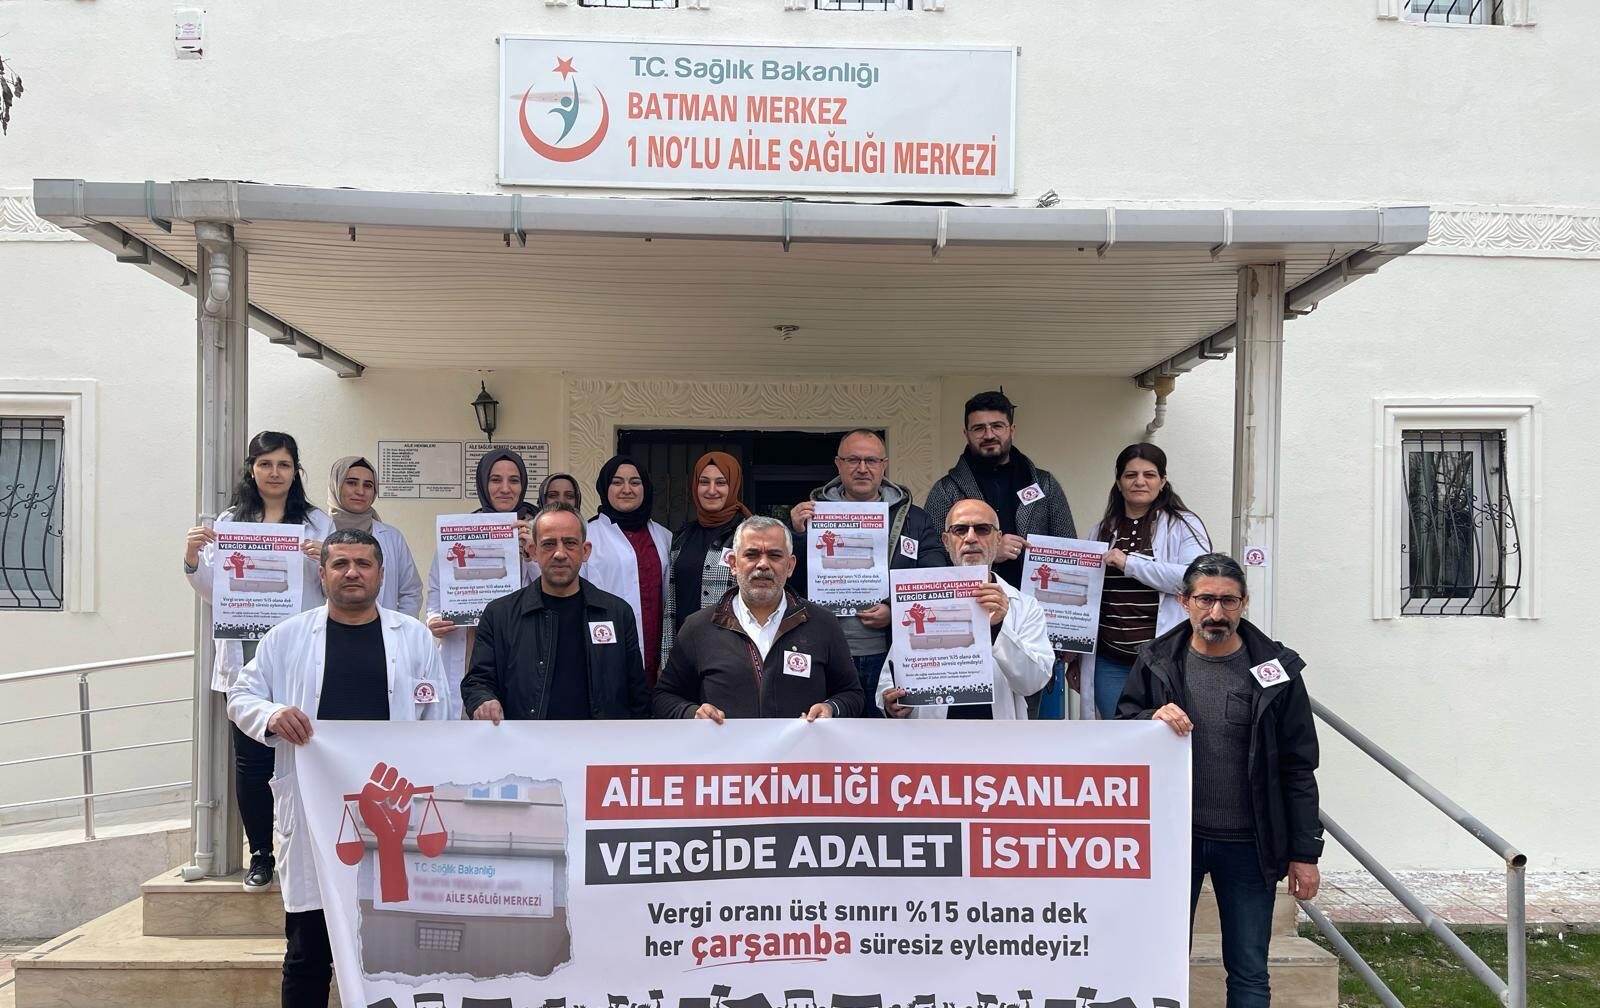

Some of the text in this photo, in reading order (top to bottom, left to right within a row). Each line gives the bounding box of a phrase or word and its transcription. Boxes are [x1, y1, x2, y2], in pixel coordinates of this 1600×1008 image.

[630, 57, 879, 88] T.C. Sağlık Bakanlığı
[628, 92, 847, 125] BATMAN MERKEZ
[627, 136, 636, 167] 1
[728, 129, 780, 171] AİLE
[789, 131, 884, 174] SAĞLIĞI
[894, 135, 996, 176] MERKEZİ
[602, 766, 1139, 812] AİLE HEKİMLİĞİ ÇALIŞANLARI
[600, 828, 1140, 876] VERGİDE ADALET İSTİYOR
[431, 863, 455, 877] Sağlık
[458, 864, 496, 878] Bakanlığı
[446, 890, 464, 903] AİLE
[466, 891, 501, 905] SAĞLIĞI
[504, 893, 542, 906] MERKEZİ
[648, 901, 1086, 928] Vergi oranı üst sınırı %15 olana dek
[646, 925, 1088, 963] her çarşamba süresiz eylemdeyiz!
